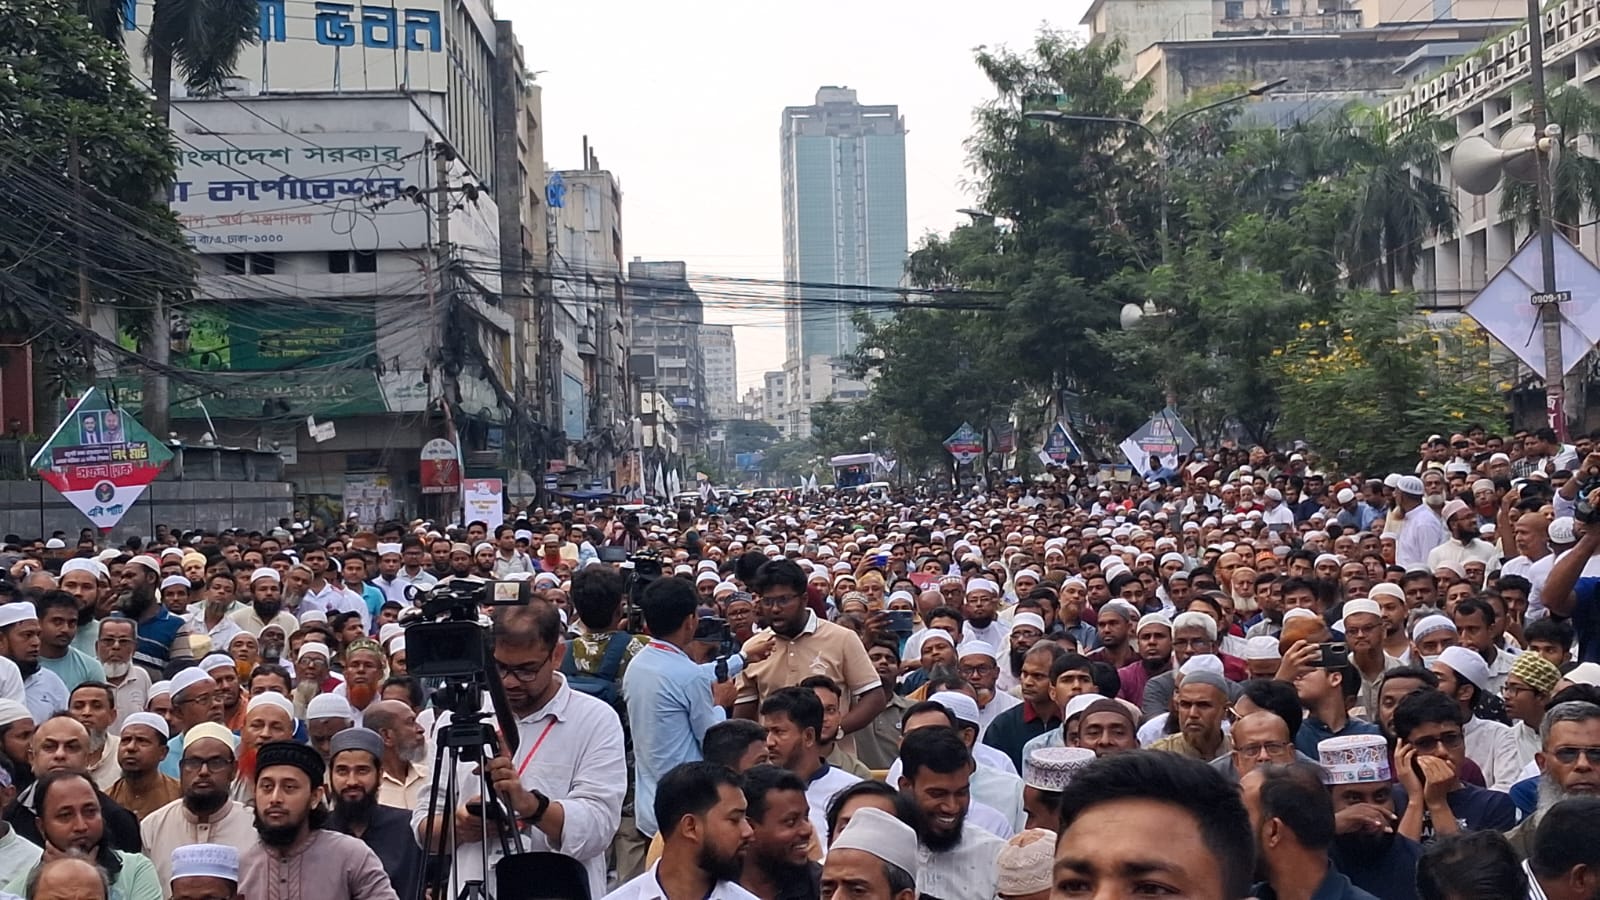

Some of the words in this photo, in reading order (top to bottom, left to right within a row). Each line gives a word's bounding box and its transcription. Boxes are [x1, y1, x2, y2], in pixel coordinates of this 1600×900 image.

[315, 1, 441, 52] ভবন
[174, 147, 292, 168] াংলাদেশ
[302, 145, 401, 164] সরকার
[208, 175, 404, 202] কর্পোরেশন
[227, 234, 283, 244] ঢাকা-১০০০
